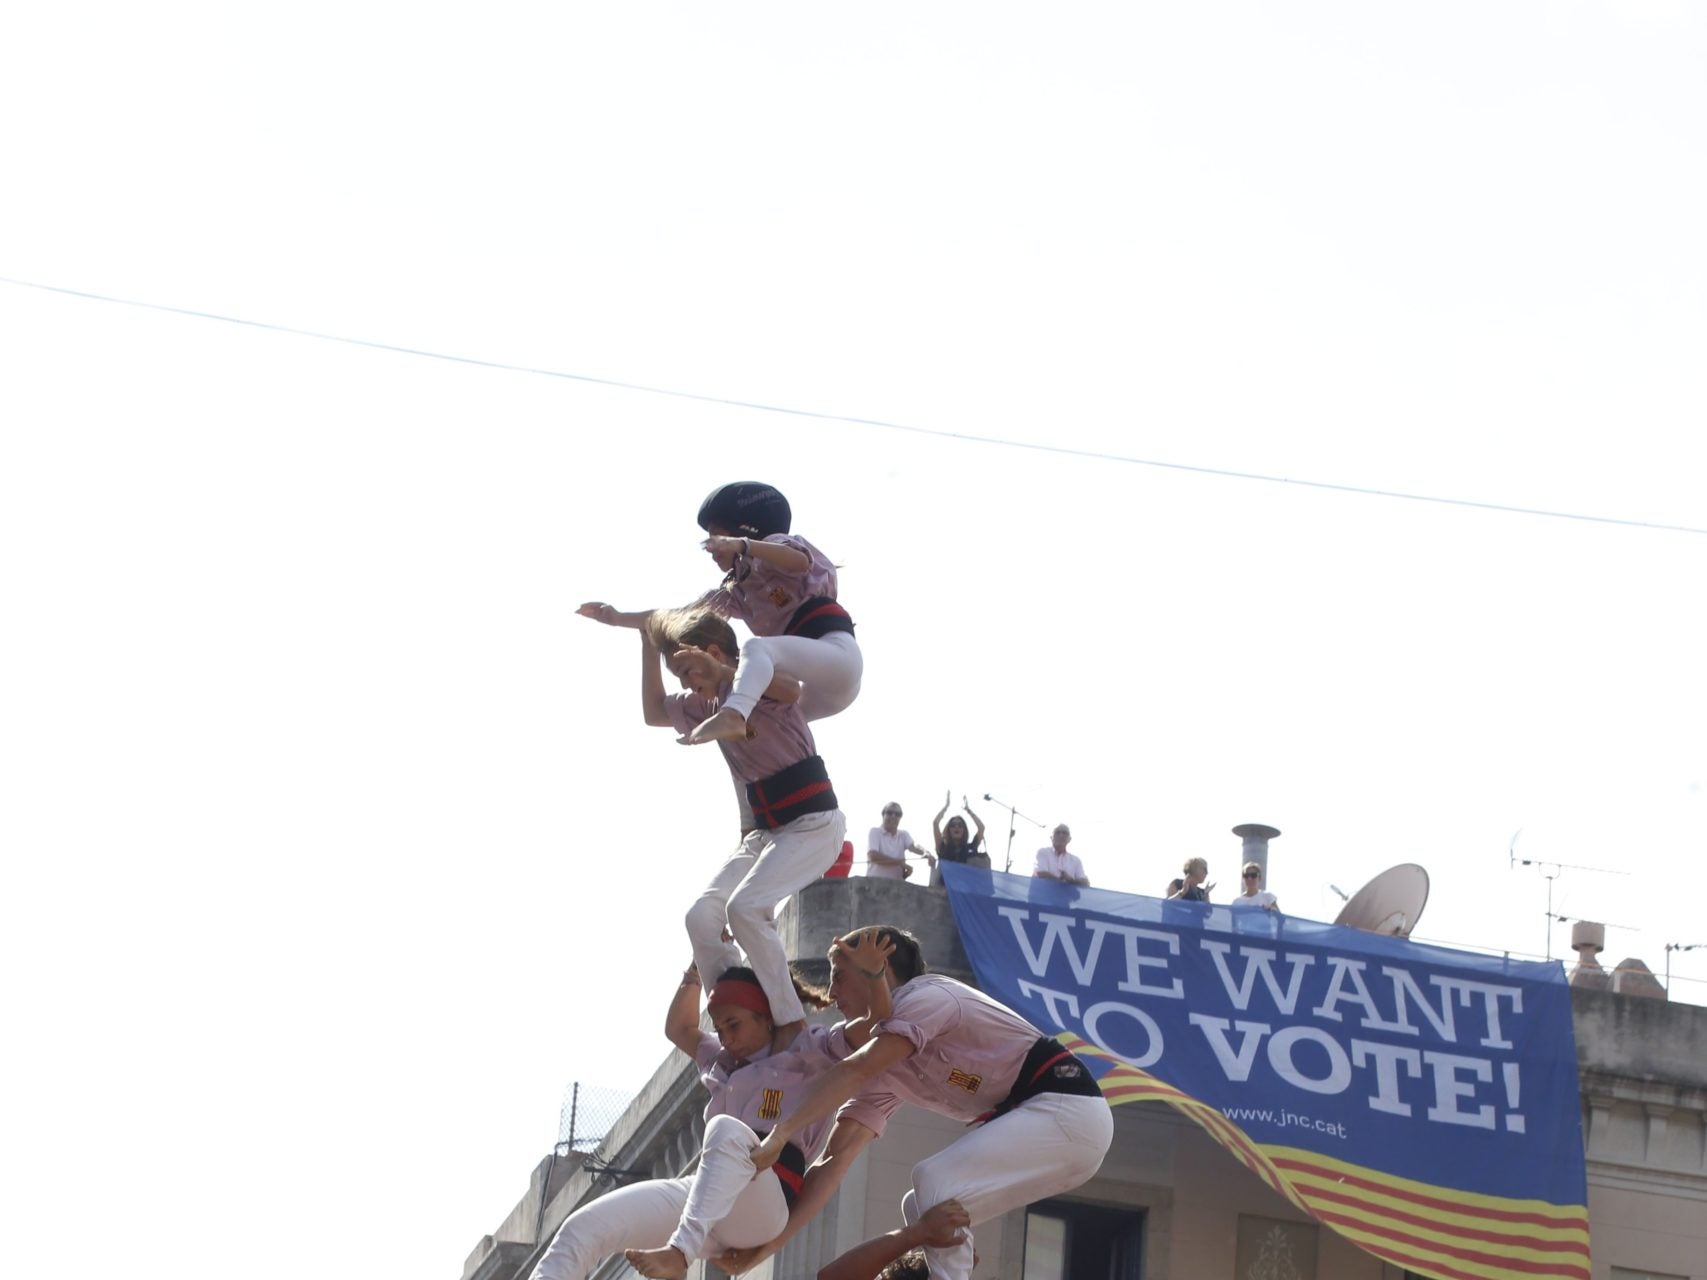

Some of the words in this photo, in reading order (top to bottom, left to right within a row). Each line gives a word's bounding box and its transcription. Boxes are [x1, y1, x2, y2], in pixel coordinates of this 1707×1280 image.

[998, 906, 1184, 999] WE
[1201, 939, 1523, 1049] WANT
[1017, 978, 1164, 1067] TO
[1189, 1012, 1525, 1134] VOTE!
[1222, 1107, 1347, 1139] www.jnc.cat
